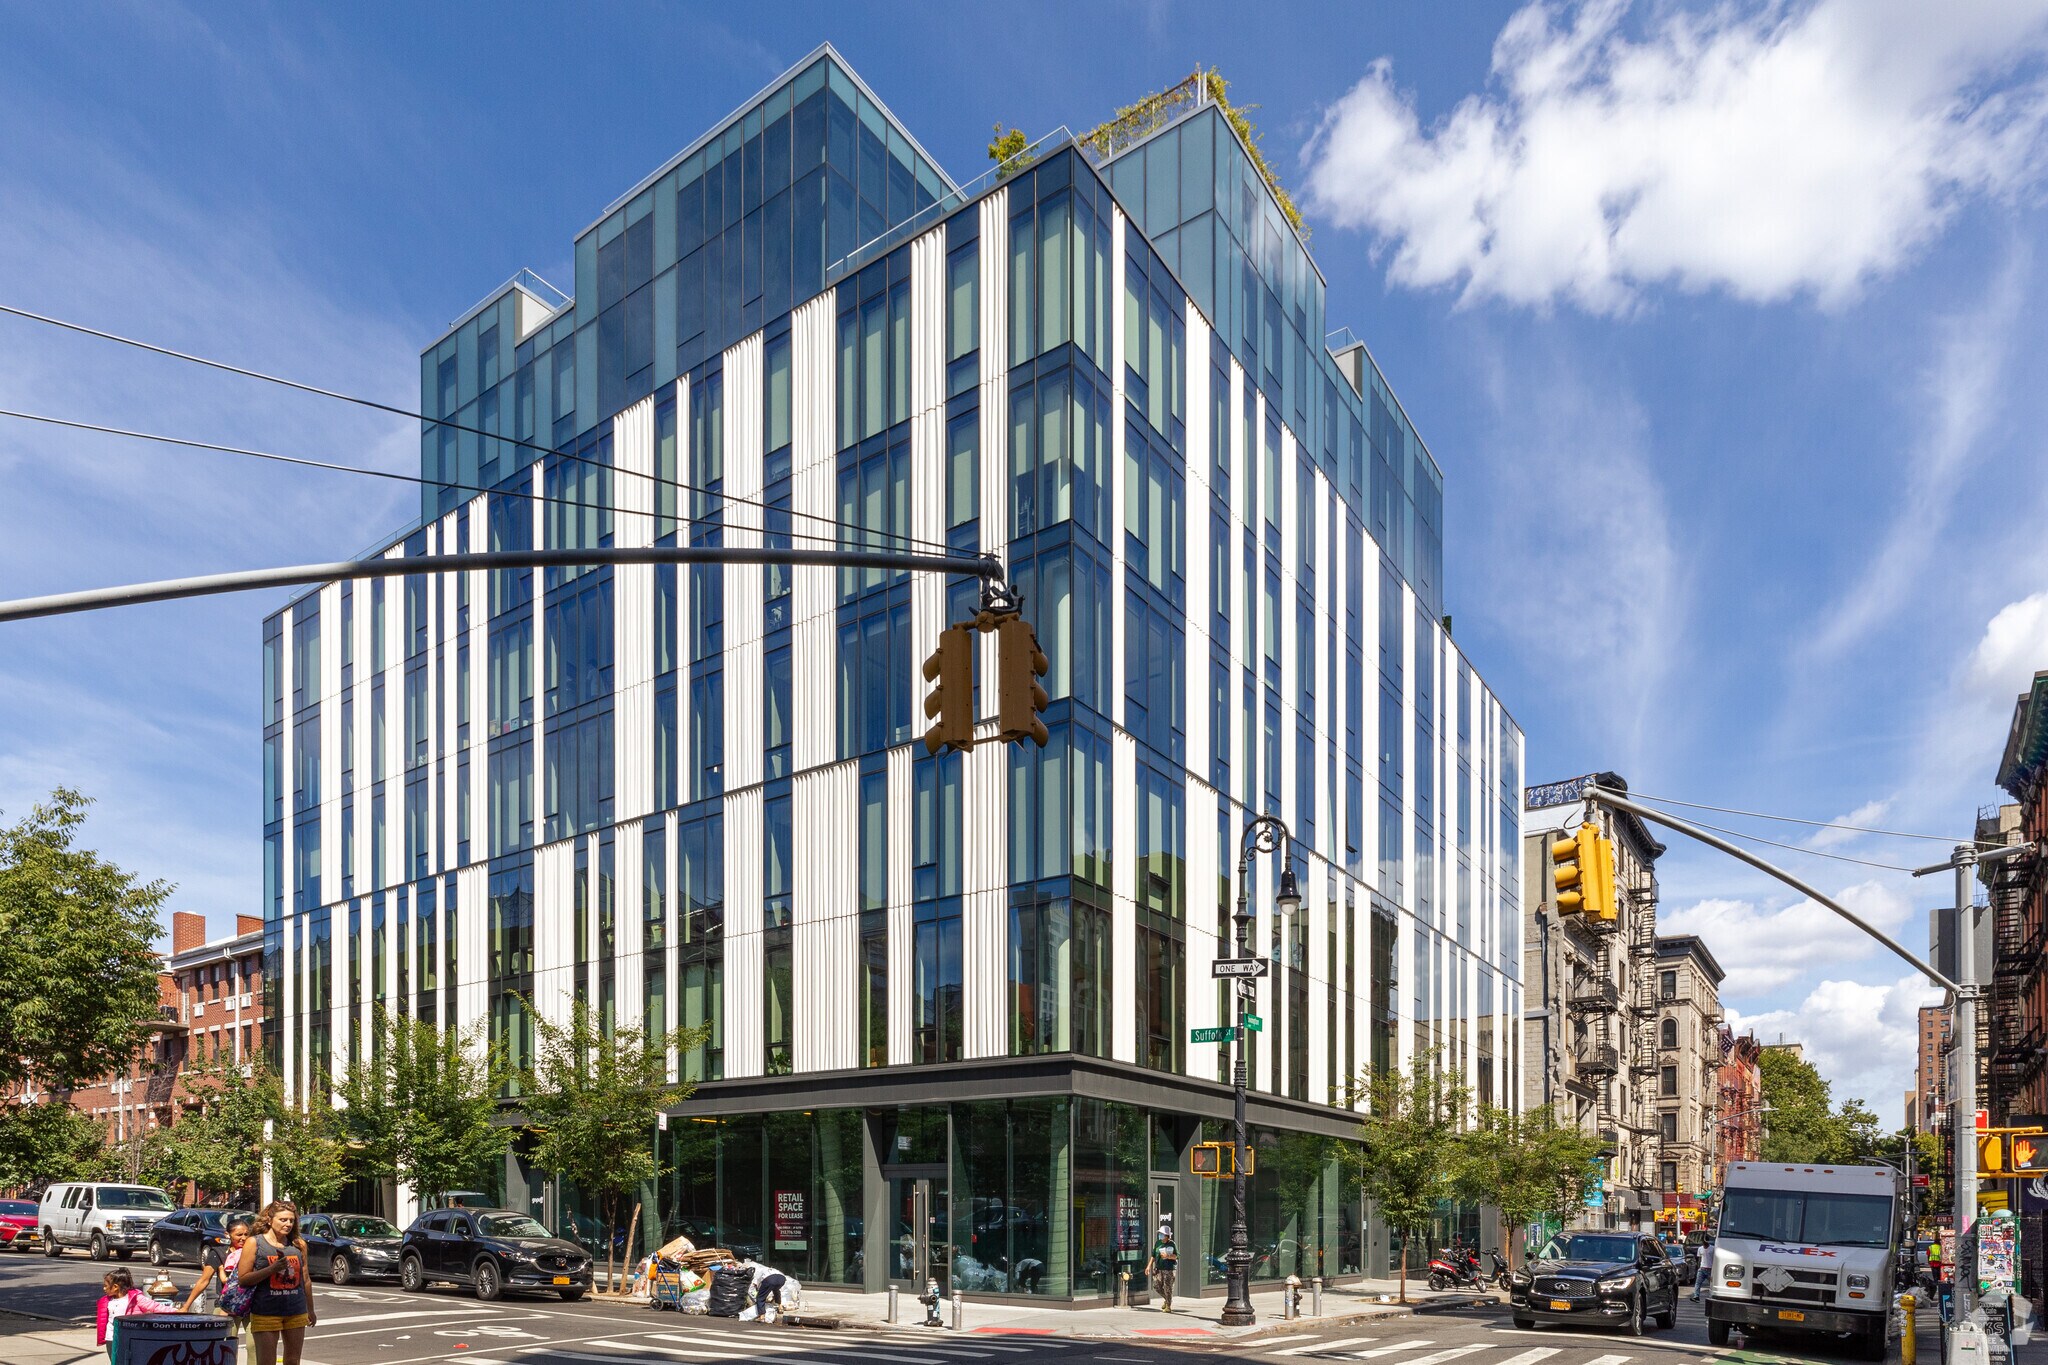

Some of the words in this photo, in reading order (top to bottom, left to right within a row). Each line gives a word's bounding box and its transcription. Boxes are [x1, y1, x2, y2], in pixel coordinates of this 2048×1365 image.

[1220, 964, 1236, 972] ONE
[1195, 1030, 1222, 1041] Suffolk
[778, 1193, 803, 1202] RETAIL
[779, 1203, 803, 1211] SPACE
[1120, 1198, 1140, 1207] RETAIL
[1120, 1209, 1139, 1218] SPACE
[1758, 1244, 1838, 1257] FedEx
